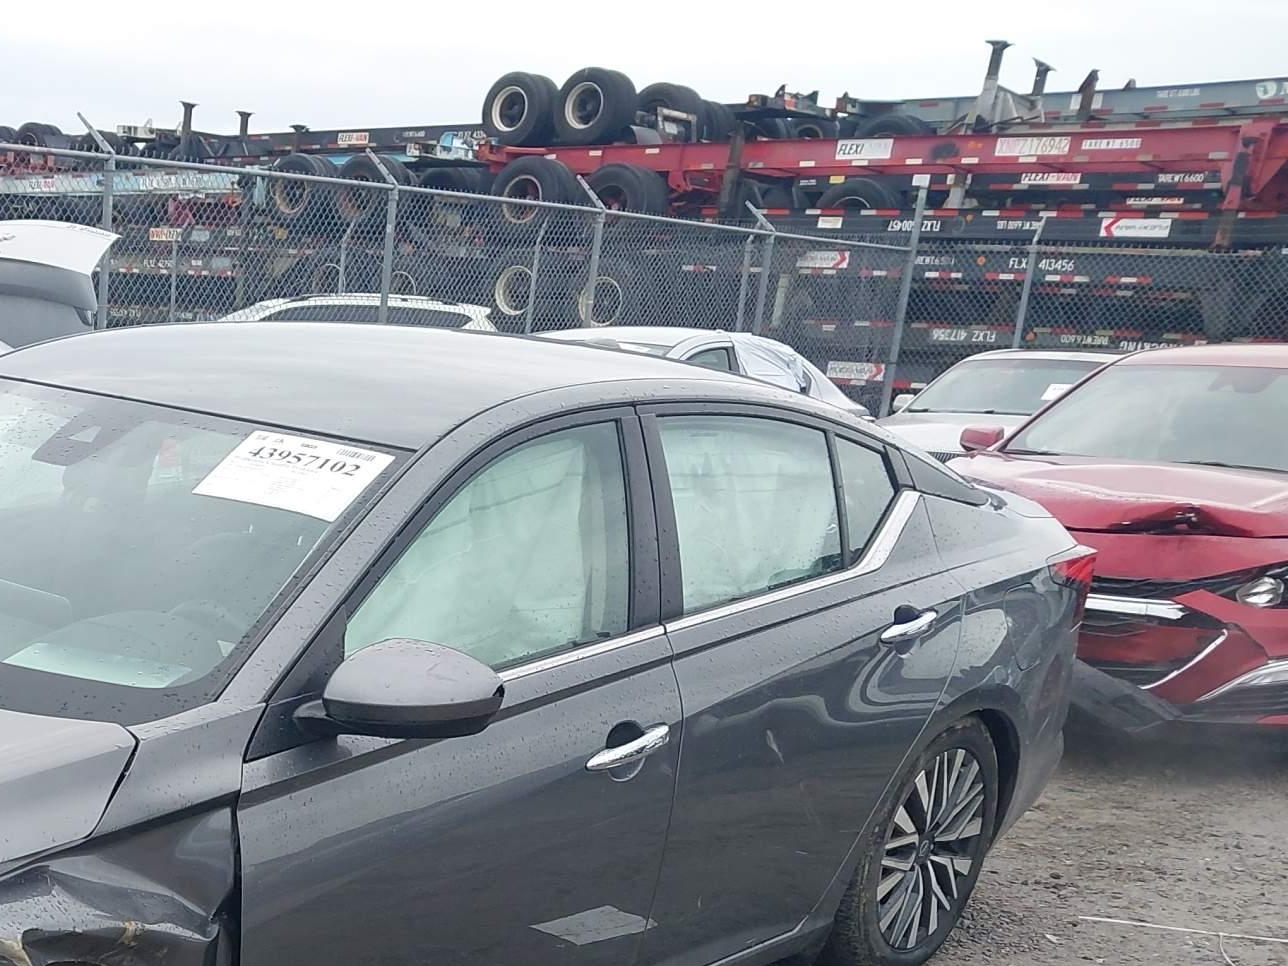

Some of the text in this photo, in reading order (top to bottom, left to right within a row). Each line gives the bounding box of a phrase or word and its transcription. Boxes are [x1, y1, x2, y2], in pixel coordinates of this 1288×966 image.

[838, 143, 865, 155] FLEXI
[1008, 257, 1075, 271] FLX 413456
[971, 330, 996, 342] FLXZ
[248, 446, 361, 477] 43957102
